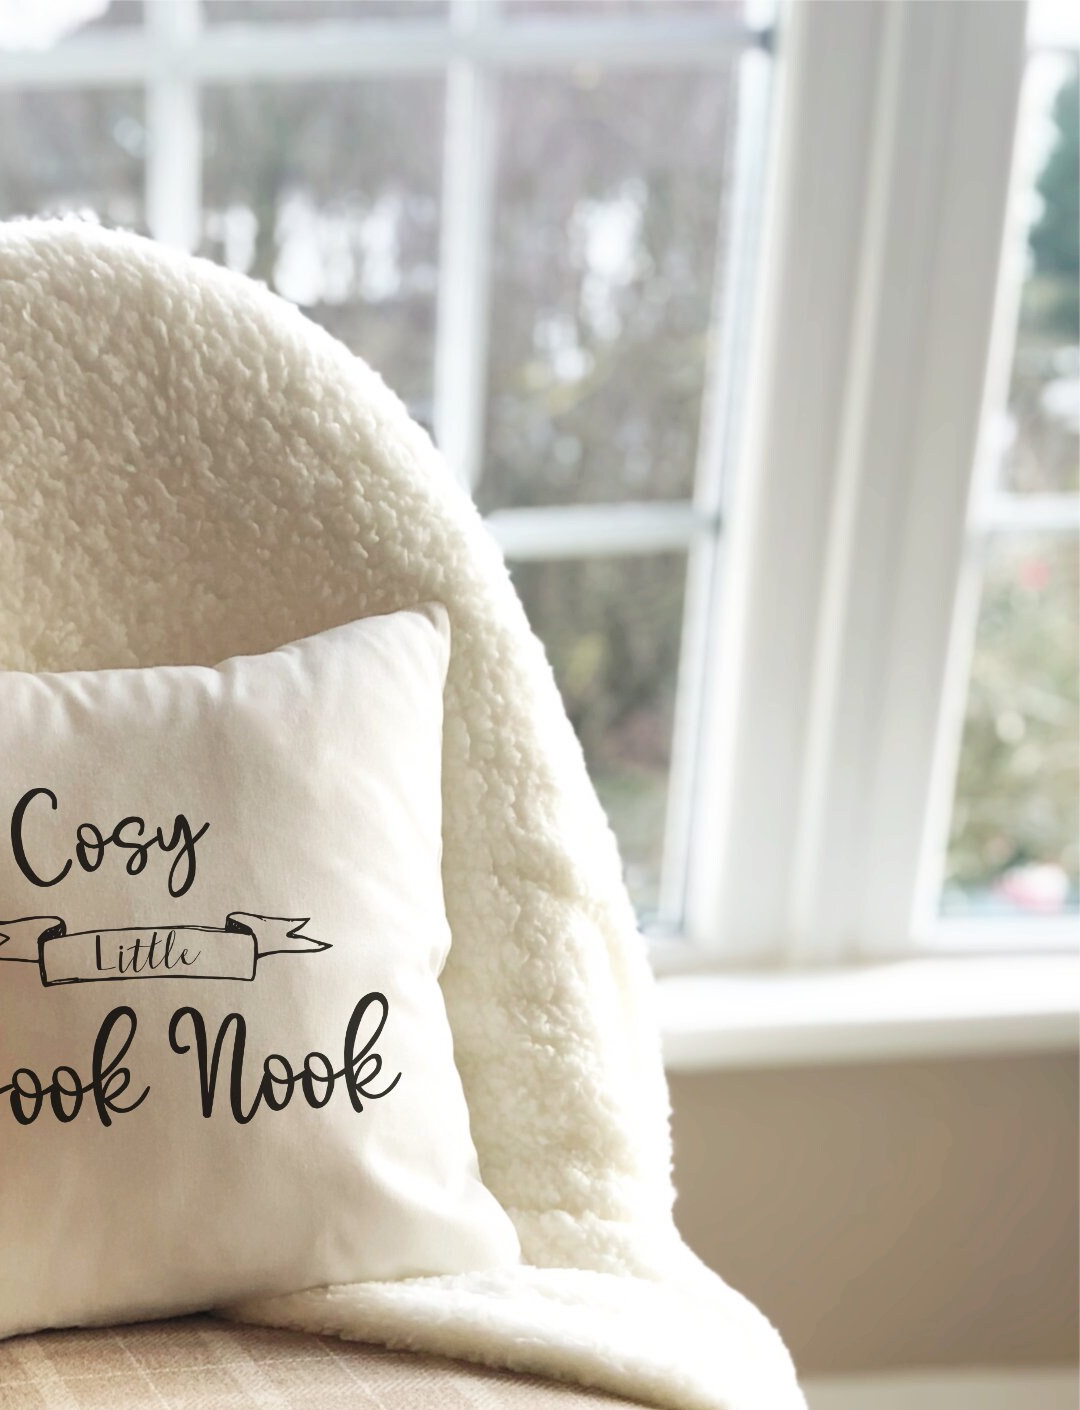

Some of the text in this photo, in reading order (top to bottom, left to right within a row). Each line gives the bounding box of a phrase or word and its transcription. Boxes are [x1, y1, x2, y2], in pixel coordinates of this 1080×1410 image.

[10, 787, 210, 898] Cosy
[95, 929, 202, 974] Little
[168, 991, 402, 1124] Nook
